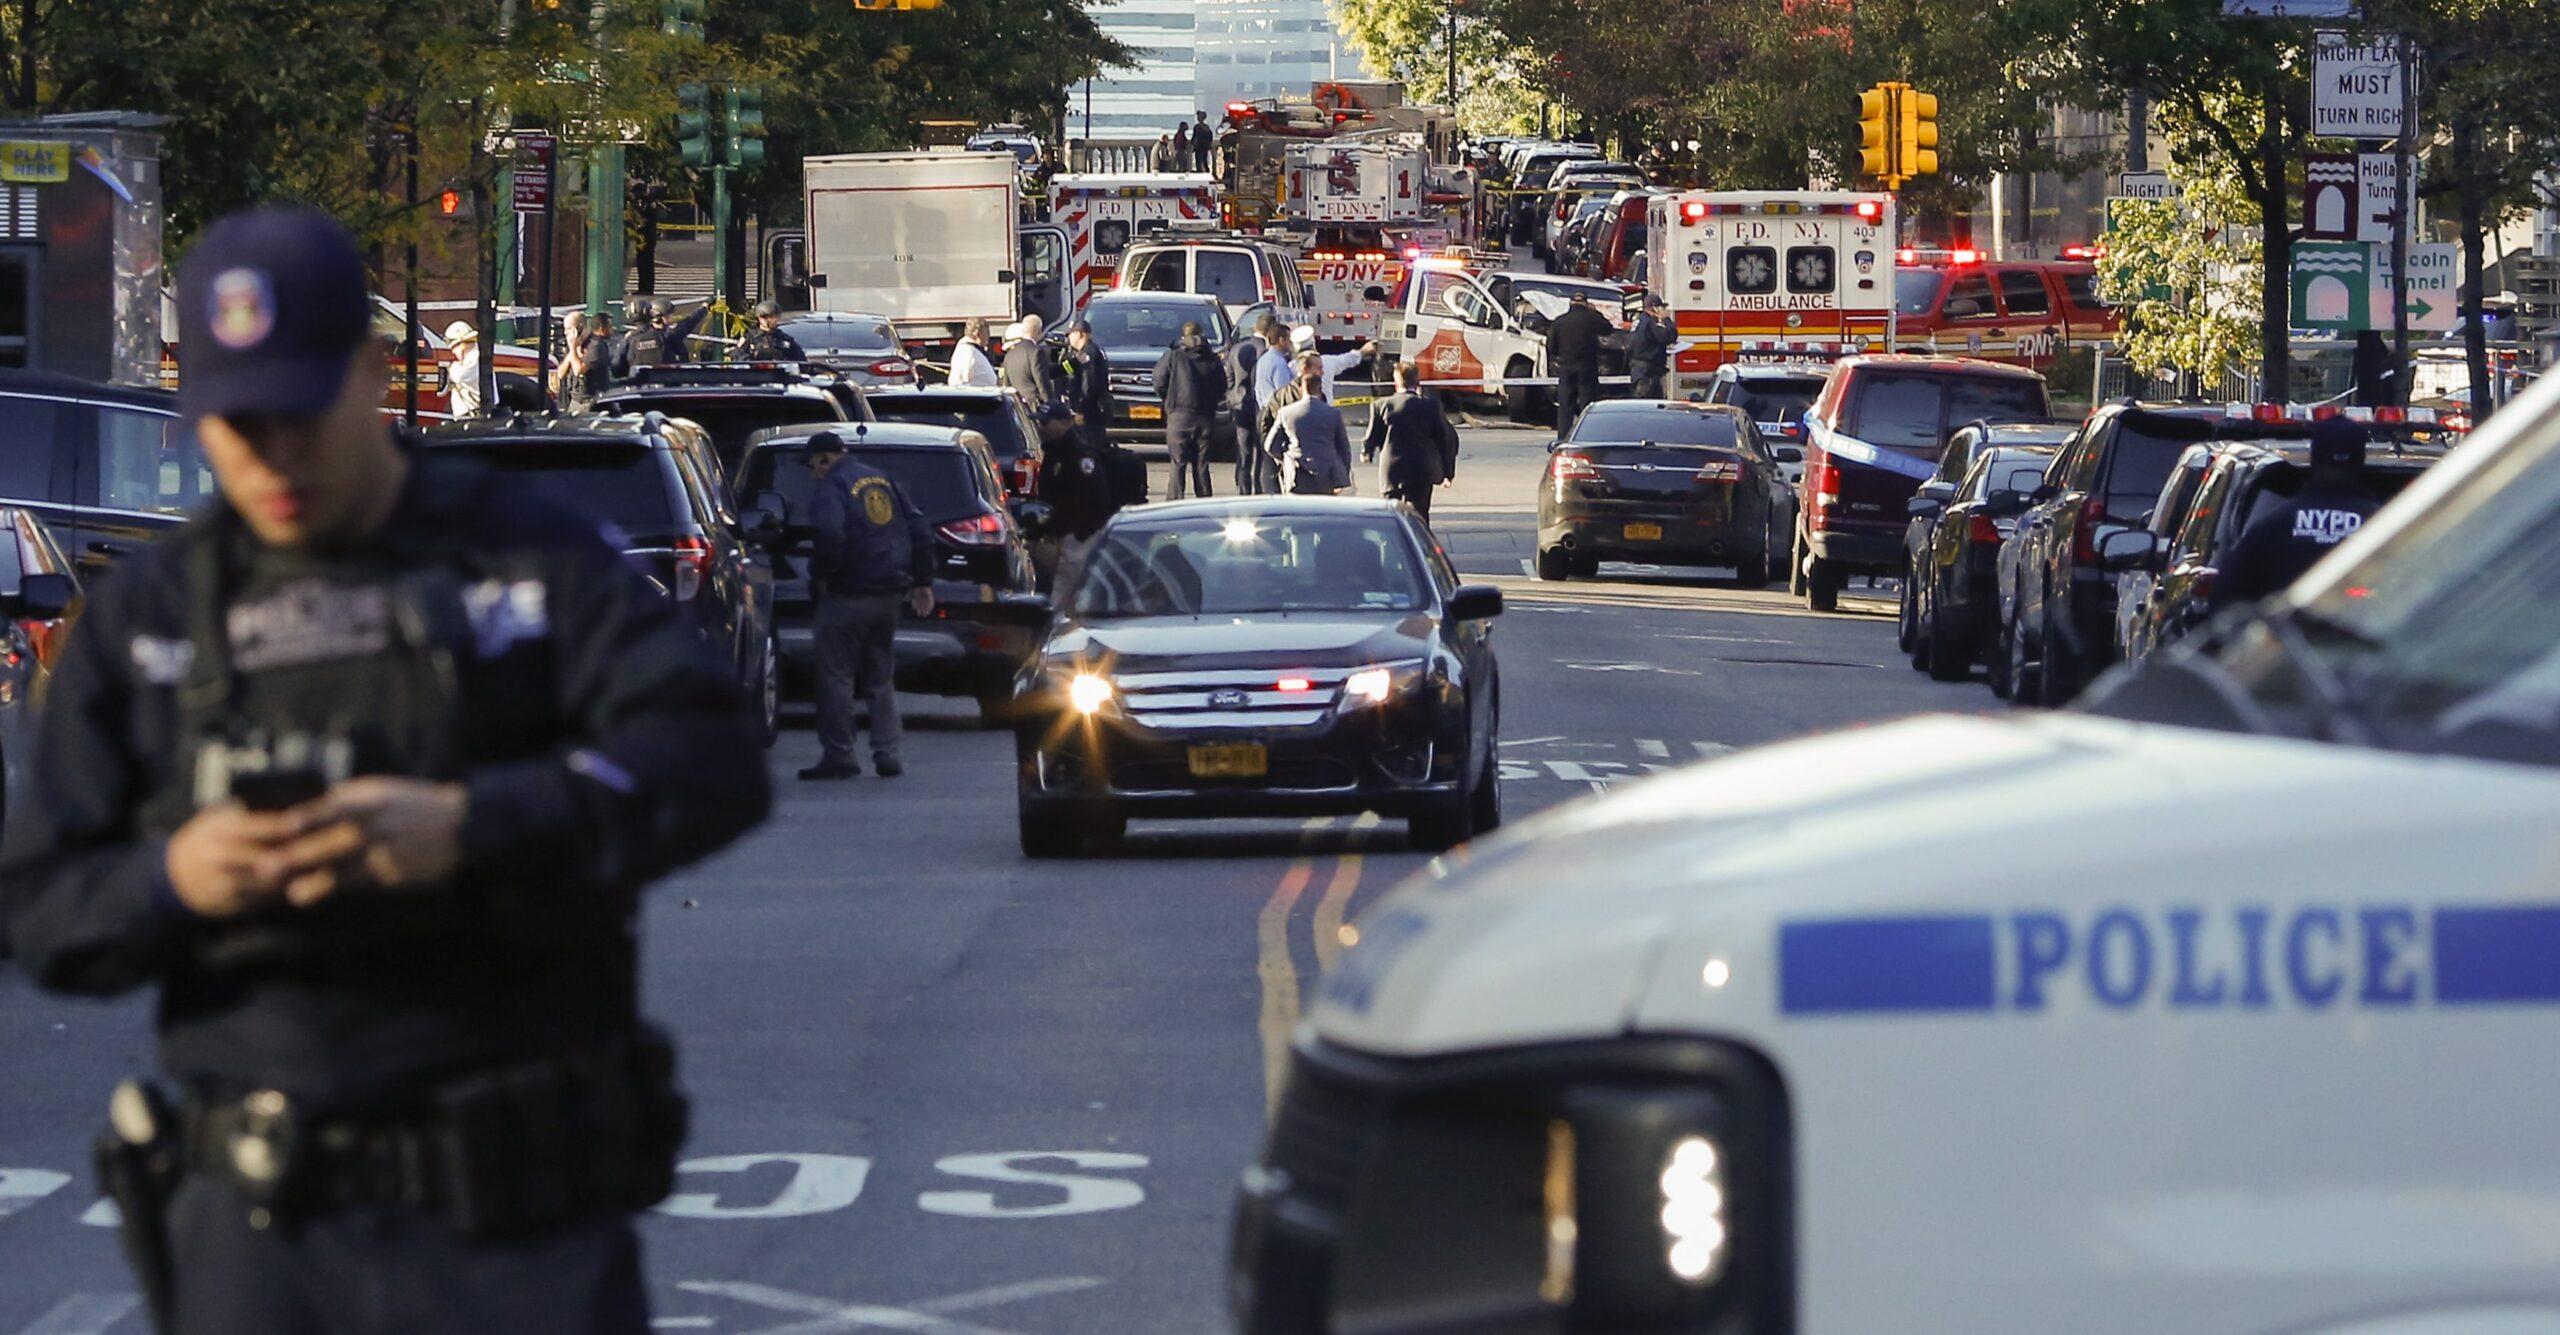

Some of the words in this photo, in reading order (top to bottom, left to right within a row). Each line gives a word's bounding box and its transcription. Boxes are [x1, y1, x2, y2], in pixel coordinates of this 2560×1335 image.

[2320, 46, 2365, 61] RIGHT
[2373, 46, 2401, 61] LAN
[2339, 75, 2391, 94] MUST
[2318, 108, 2358, 124] TURN
[2365, 108, 2401, 124] RIGH
[15, 149, 54, 160] PLAY
[14, 164, 56, 176] HERE
[2363, 161, 2412, 177] Hollad
[1291, 170, 1302, 198] 1
[1398, 170, 1410, 198] 1
[2126, 185, 2163, 197] RIGHT
[2366, 183, 2396, 198] Tunn
[1100, 202, 1124, 214] F.D.
[1144, 202, 1169, 214] N.Y.
[1327, 203, 1373, 215] F.D.N.Y.
[1735, 222, 1770, 238] F.D.
[1794, 222, 1828, 238] N.Y.
[1853, 226, 1876, 238] 403
[2377, 252, 2449, 267] Lcoln
[1320, 263, 1383, 281] FDNY
[2381, 274, 2446, 289] Tnnel
[1729, 294, 1833, 310] AMBULANCE
[2015, 333, 2059, 357] FDNY
[2296, 509, 2362, 531] NYPD
[2013, 909, 2417, 1010] POLICE
